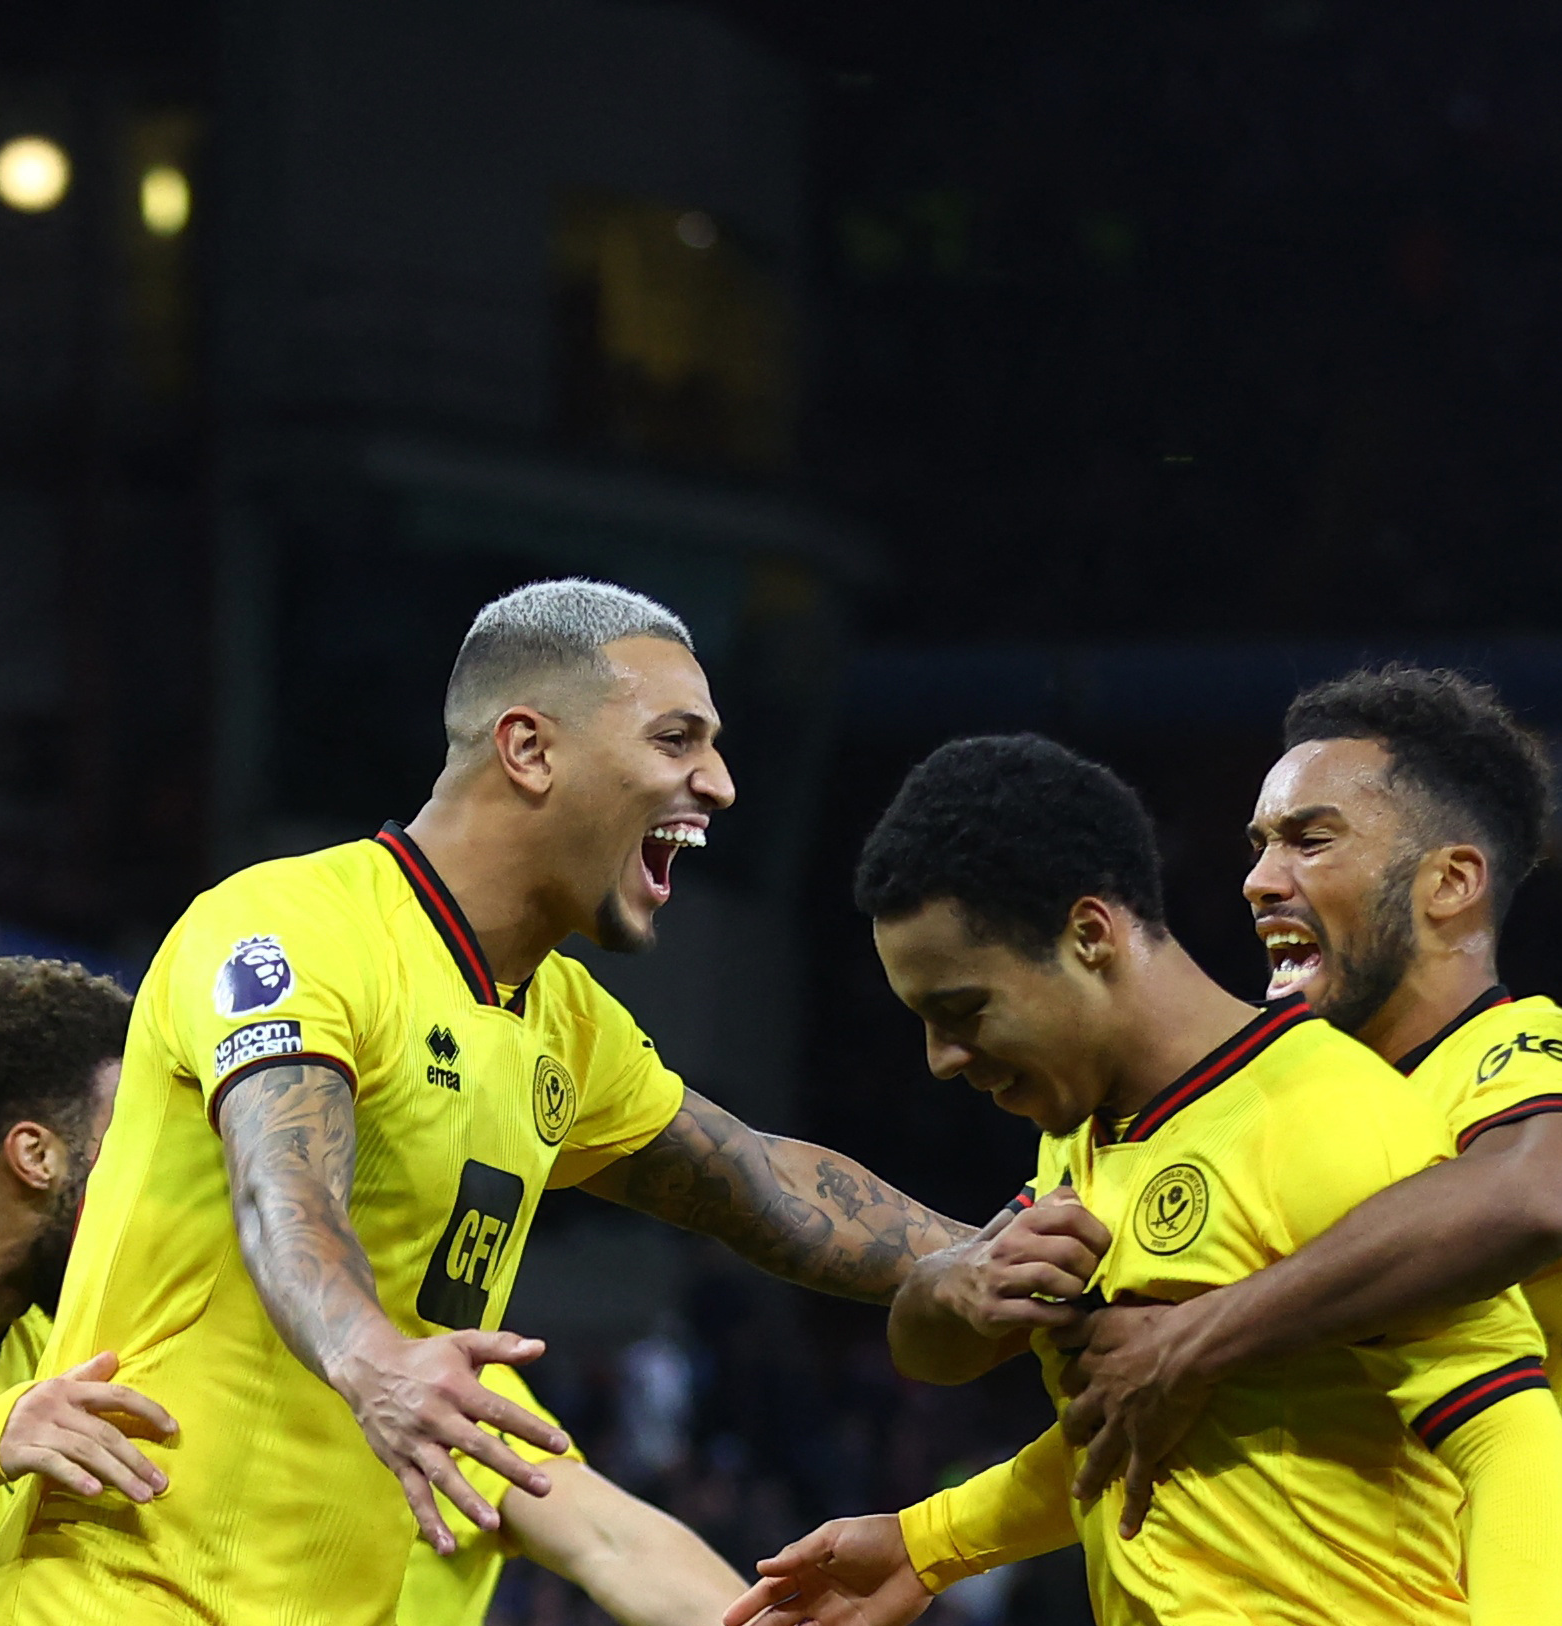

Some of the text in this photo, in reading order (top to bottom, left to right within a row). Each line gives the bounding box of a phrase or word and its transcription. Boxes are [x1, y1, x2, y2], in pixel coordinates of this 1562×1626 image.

[234, 1023, 290, 1050] room
[234, 1036, 301, 1065] racism
[446, 1209, 508, 1291] CFI
